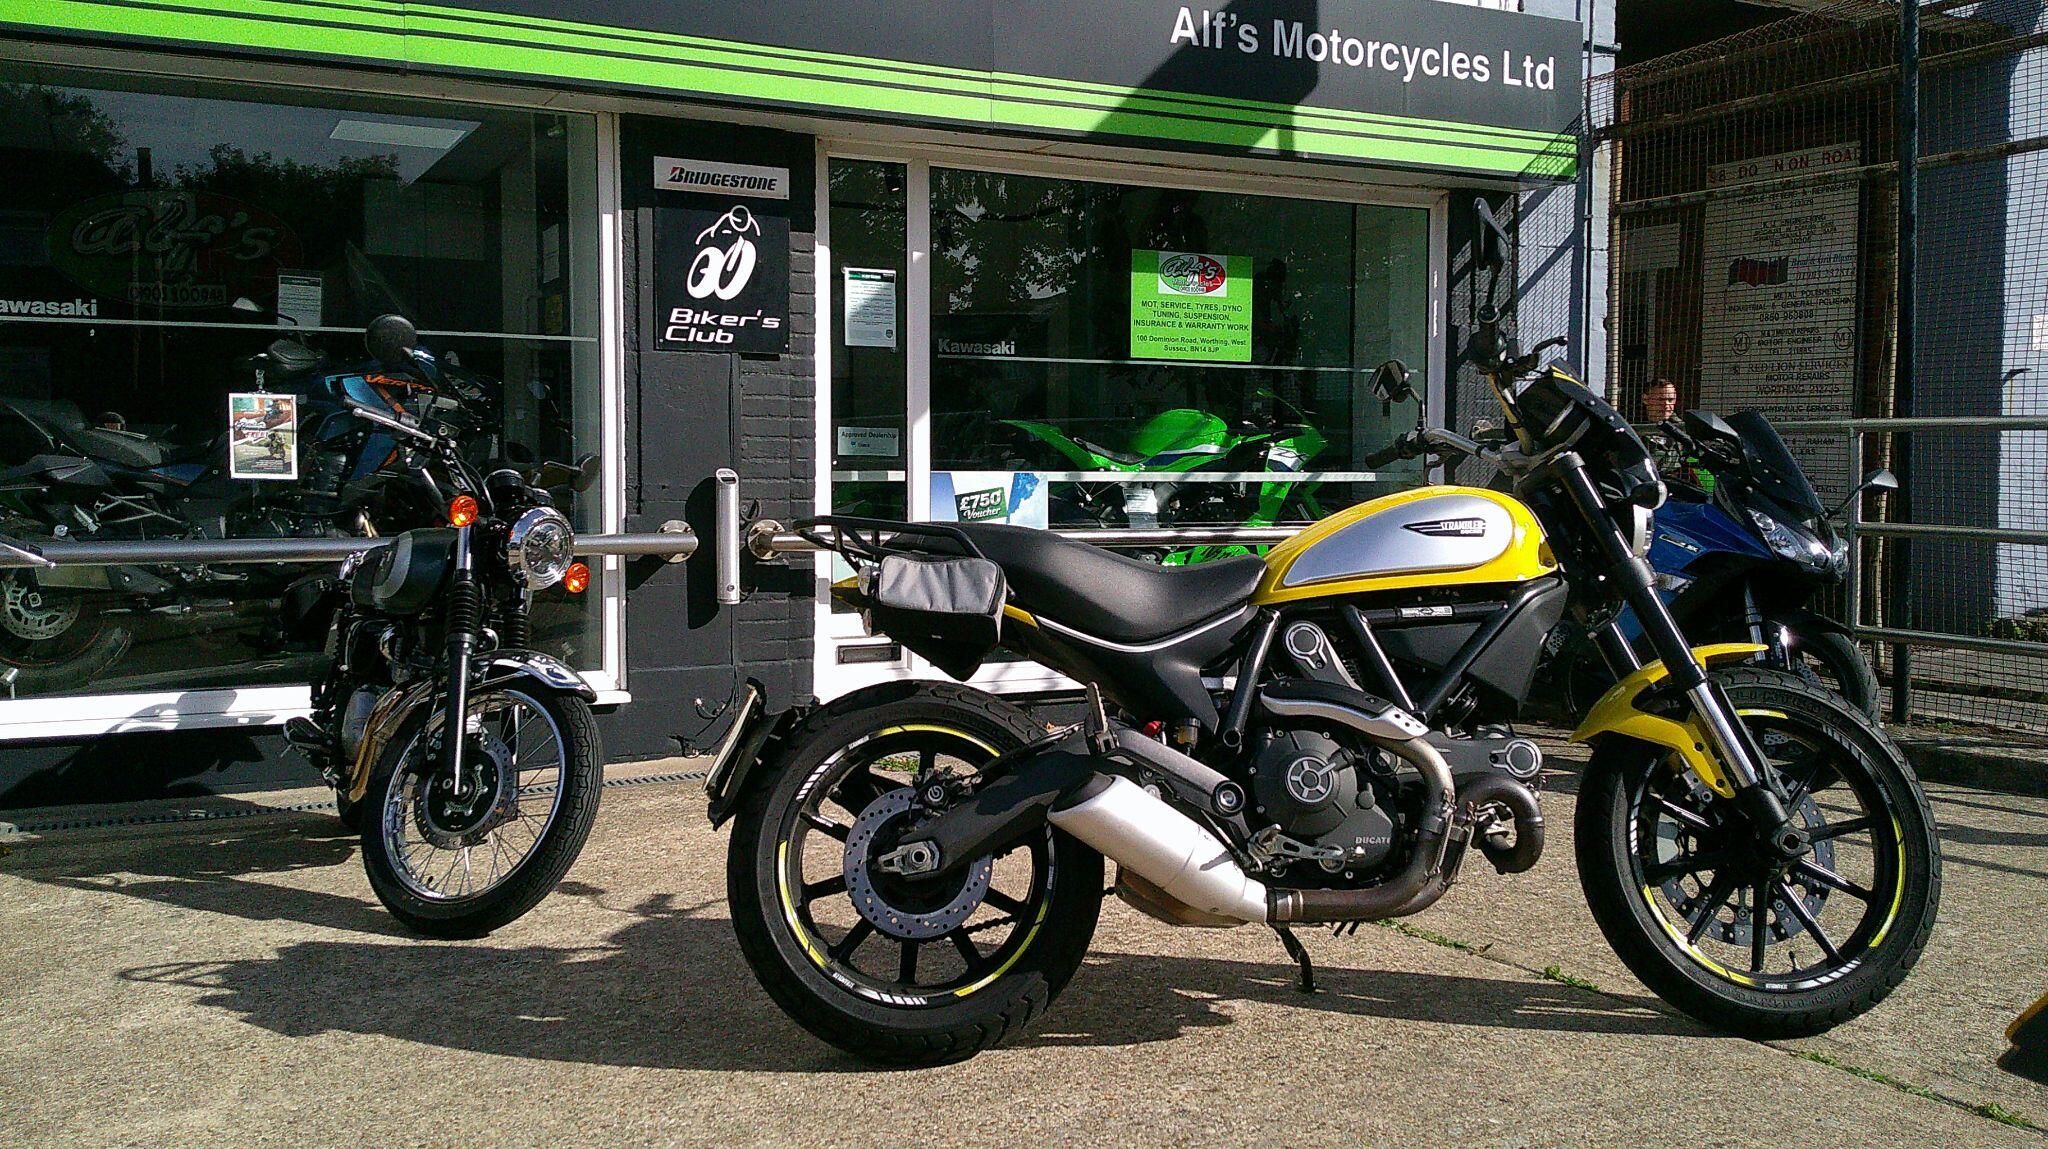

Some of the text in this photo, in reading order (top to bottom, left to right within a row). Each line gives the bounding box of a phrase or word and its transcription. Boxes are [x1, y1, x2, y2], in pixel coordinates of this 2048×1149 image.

[1169, 5, 1556, 91] Alf's Motorcycles Ltd
[667, 166, 778, 191] BRIDGESTONE
[1222, 304, 1243, 313] DYNO
[669, 306, 781, 329] Biker's
[1133, 319, 1177, 329] INSURANCE
[1185, 321, 1226, 331] WARRANTY
[1227, 322, 1249, 332] WORK
[665, 324, 735, 344] Club
[1136, 334, 1148, 342] 100
[1149, 335, 1179, 343] Dominion
[1231, 338, 1247, 346] West
[937, 337, 1016, 357] Kawasaki
[1189, 345, 1207, 353] BN14
[841, 431, 897, 440] Approved Dealership
[959, 489, 1003, 512] £750
[963, 506, 1001, 520] Voucher
[1355, 836, 1392, 845] DUCATI
